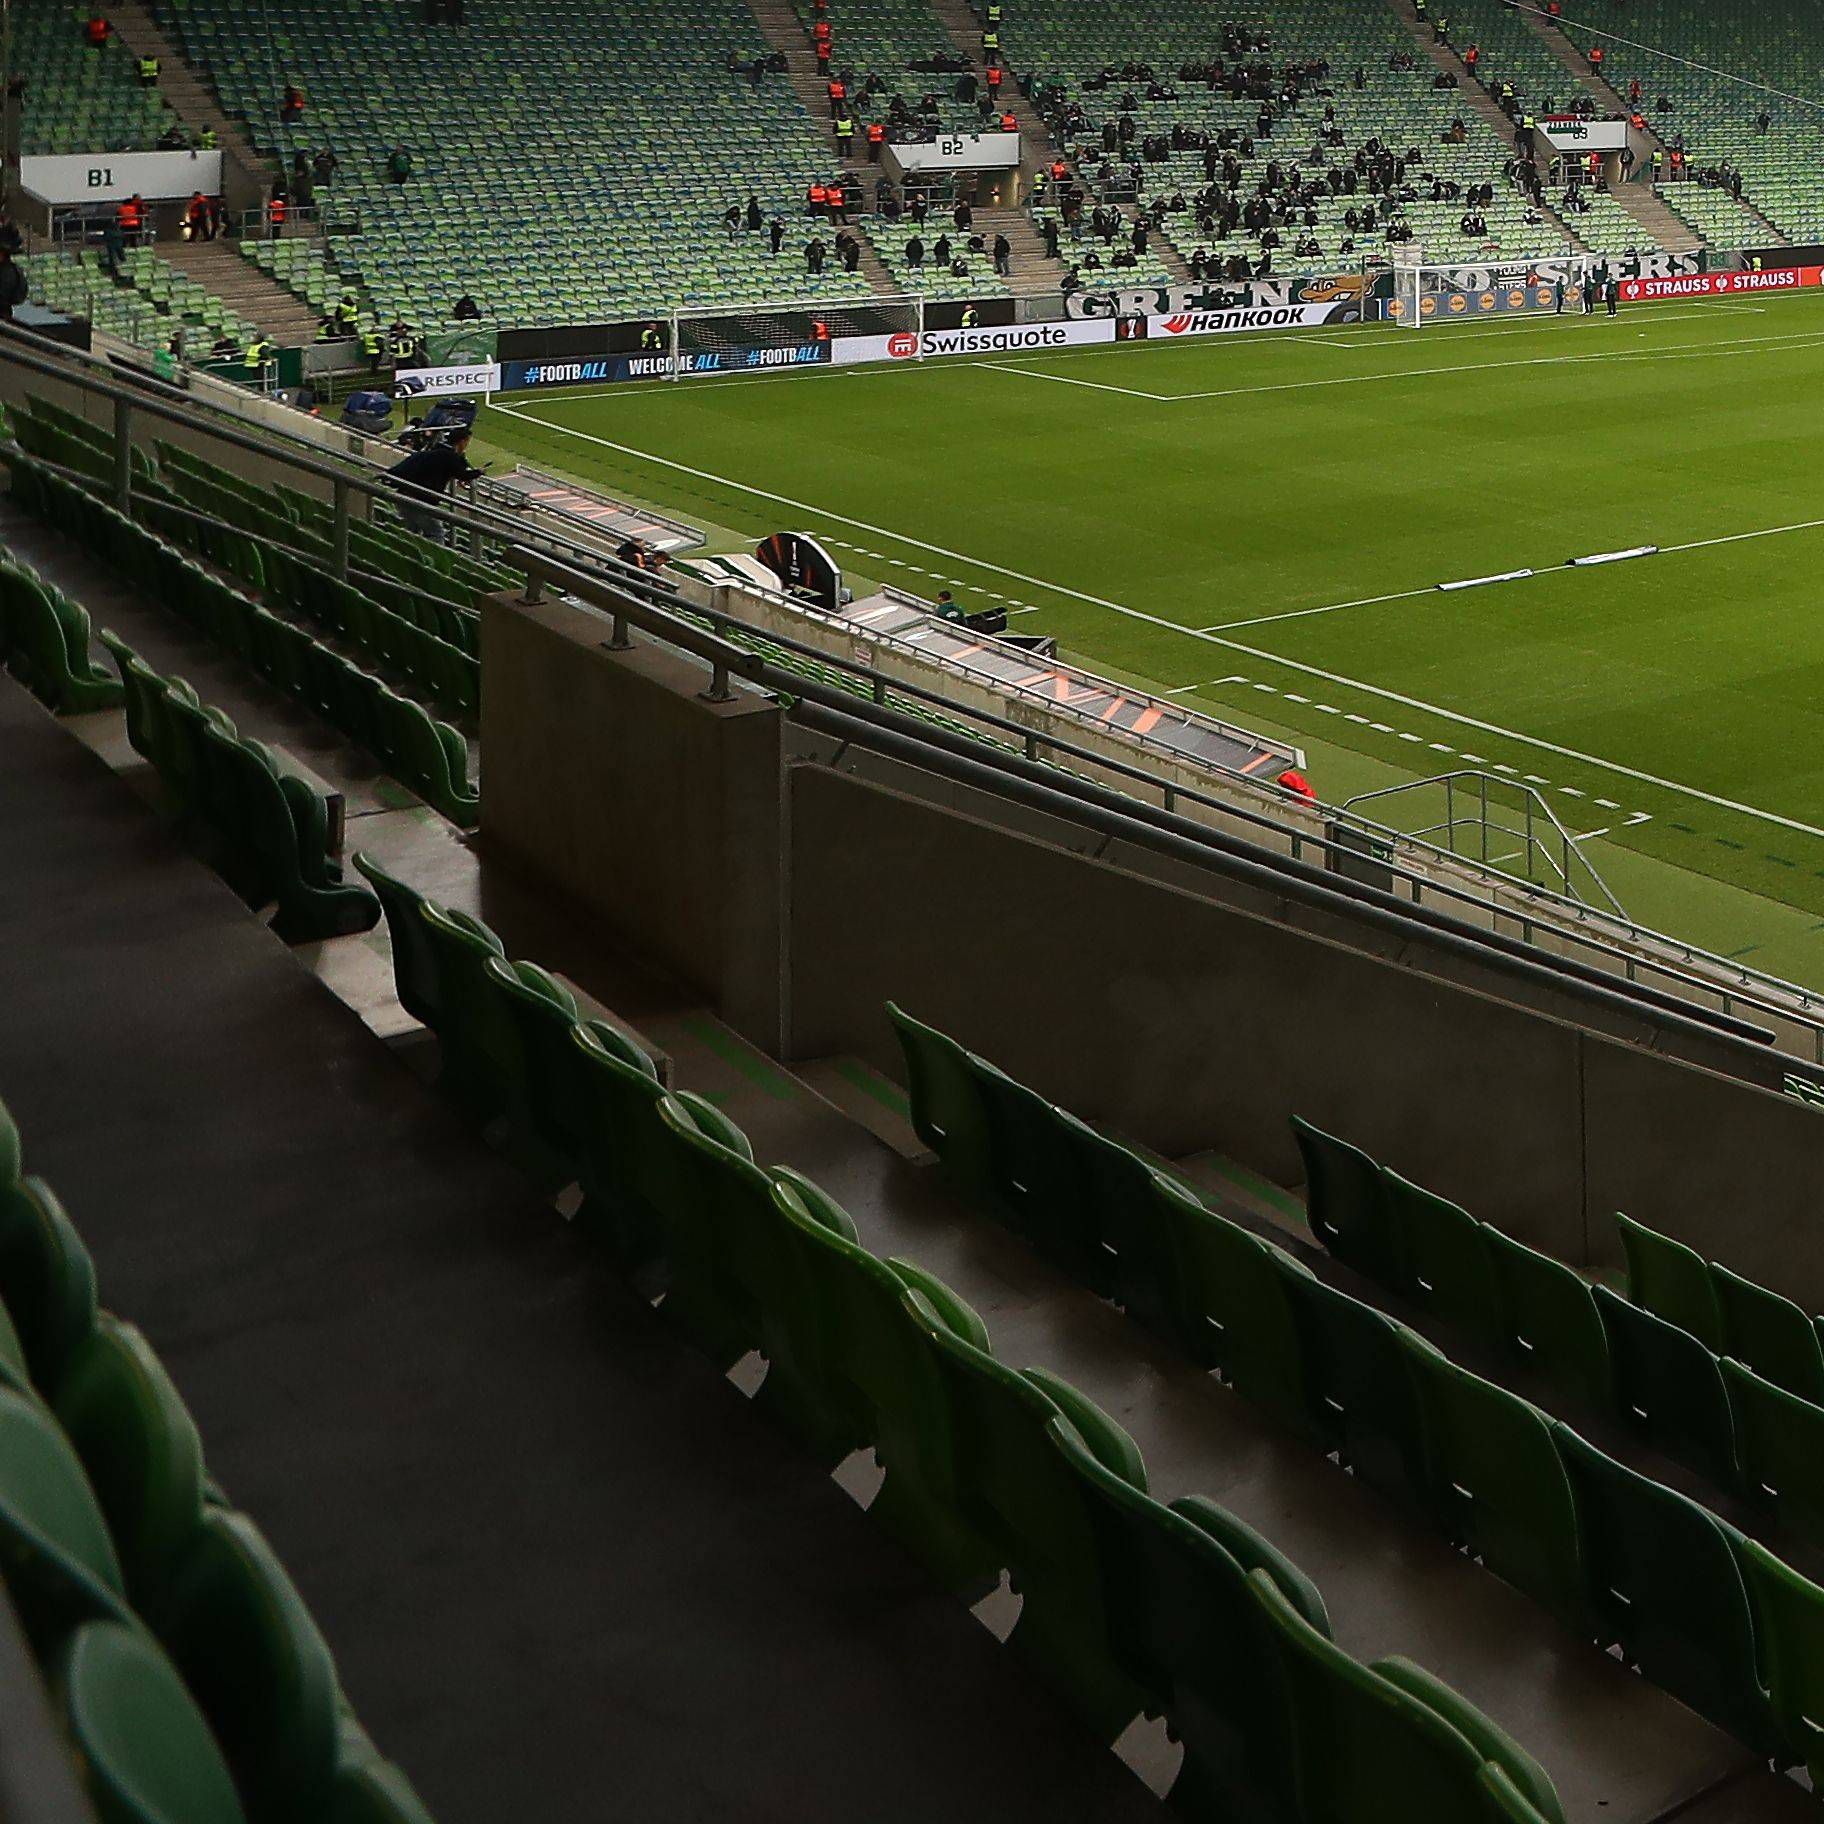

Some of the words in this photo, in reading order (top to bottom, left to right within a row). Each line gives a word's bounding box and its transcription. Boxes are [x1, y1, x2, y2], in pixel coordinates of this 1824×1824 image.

[942, 141, 964, 156] B2
[87, 169, 114, 187] B1
[1645, 278, 1710, 296] STRAUSS
[1733, 271, 1794, 289] STRAUSS
[1065, 280, 1293, 318] GREEN
[922, 326, 1066, 354] Swissquote
[628, 357, 694, 376] WELCOME
[694, 353, 721, 369] ALL
[746, 346, 820, 366] #FOOTBALL
[425, 371, 494, 387] RESPECT
[525, 362, 607, 384] #FOOTBALL
